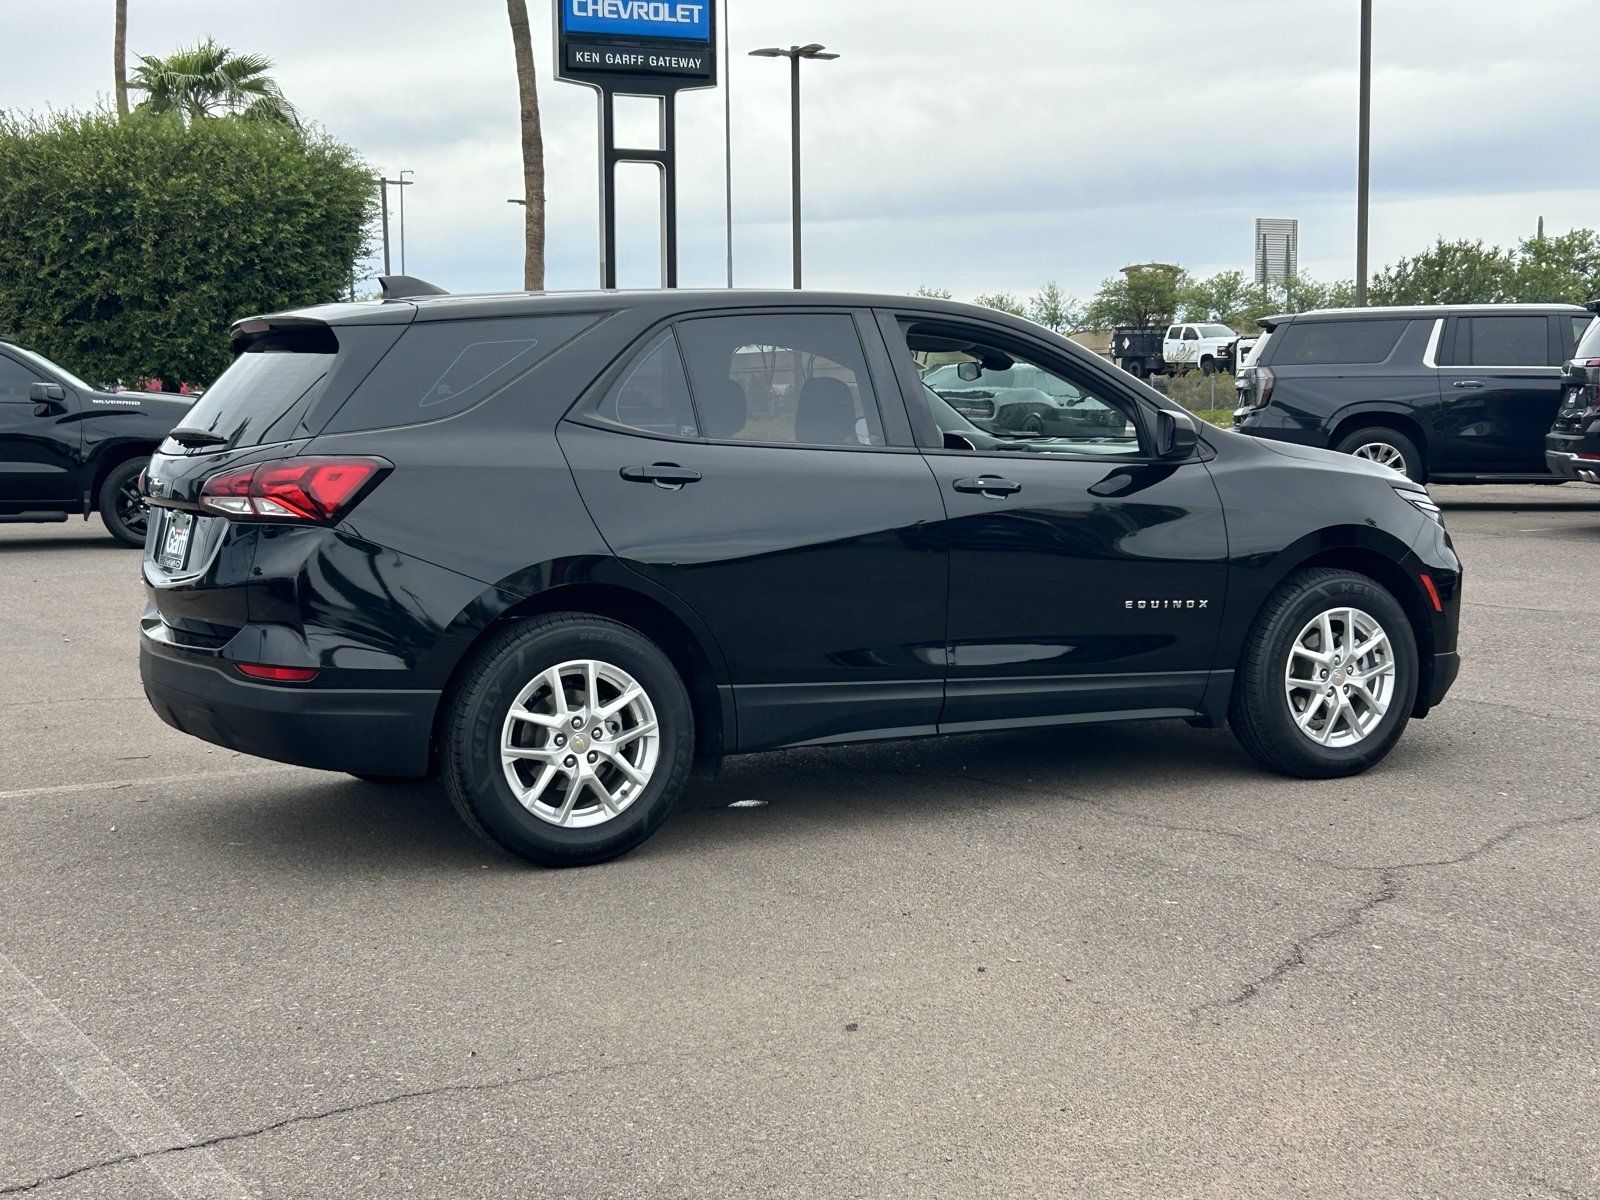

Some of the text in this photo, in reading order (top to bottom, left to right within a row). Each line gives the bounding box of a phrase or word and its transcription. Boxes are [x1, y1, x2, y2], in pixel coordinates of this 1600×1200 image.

[572, 0, 703, 23] CHEVROLET
[576, 52, 702, 69] KEN GARFF GATEWAY
[1125, 600, 1208, 609] EQUINOX
